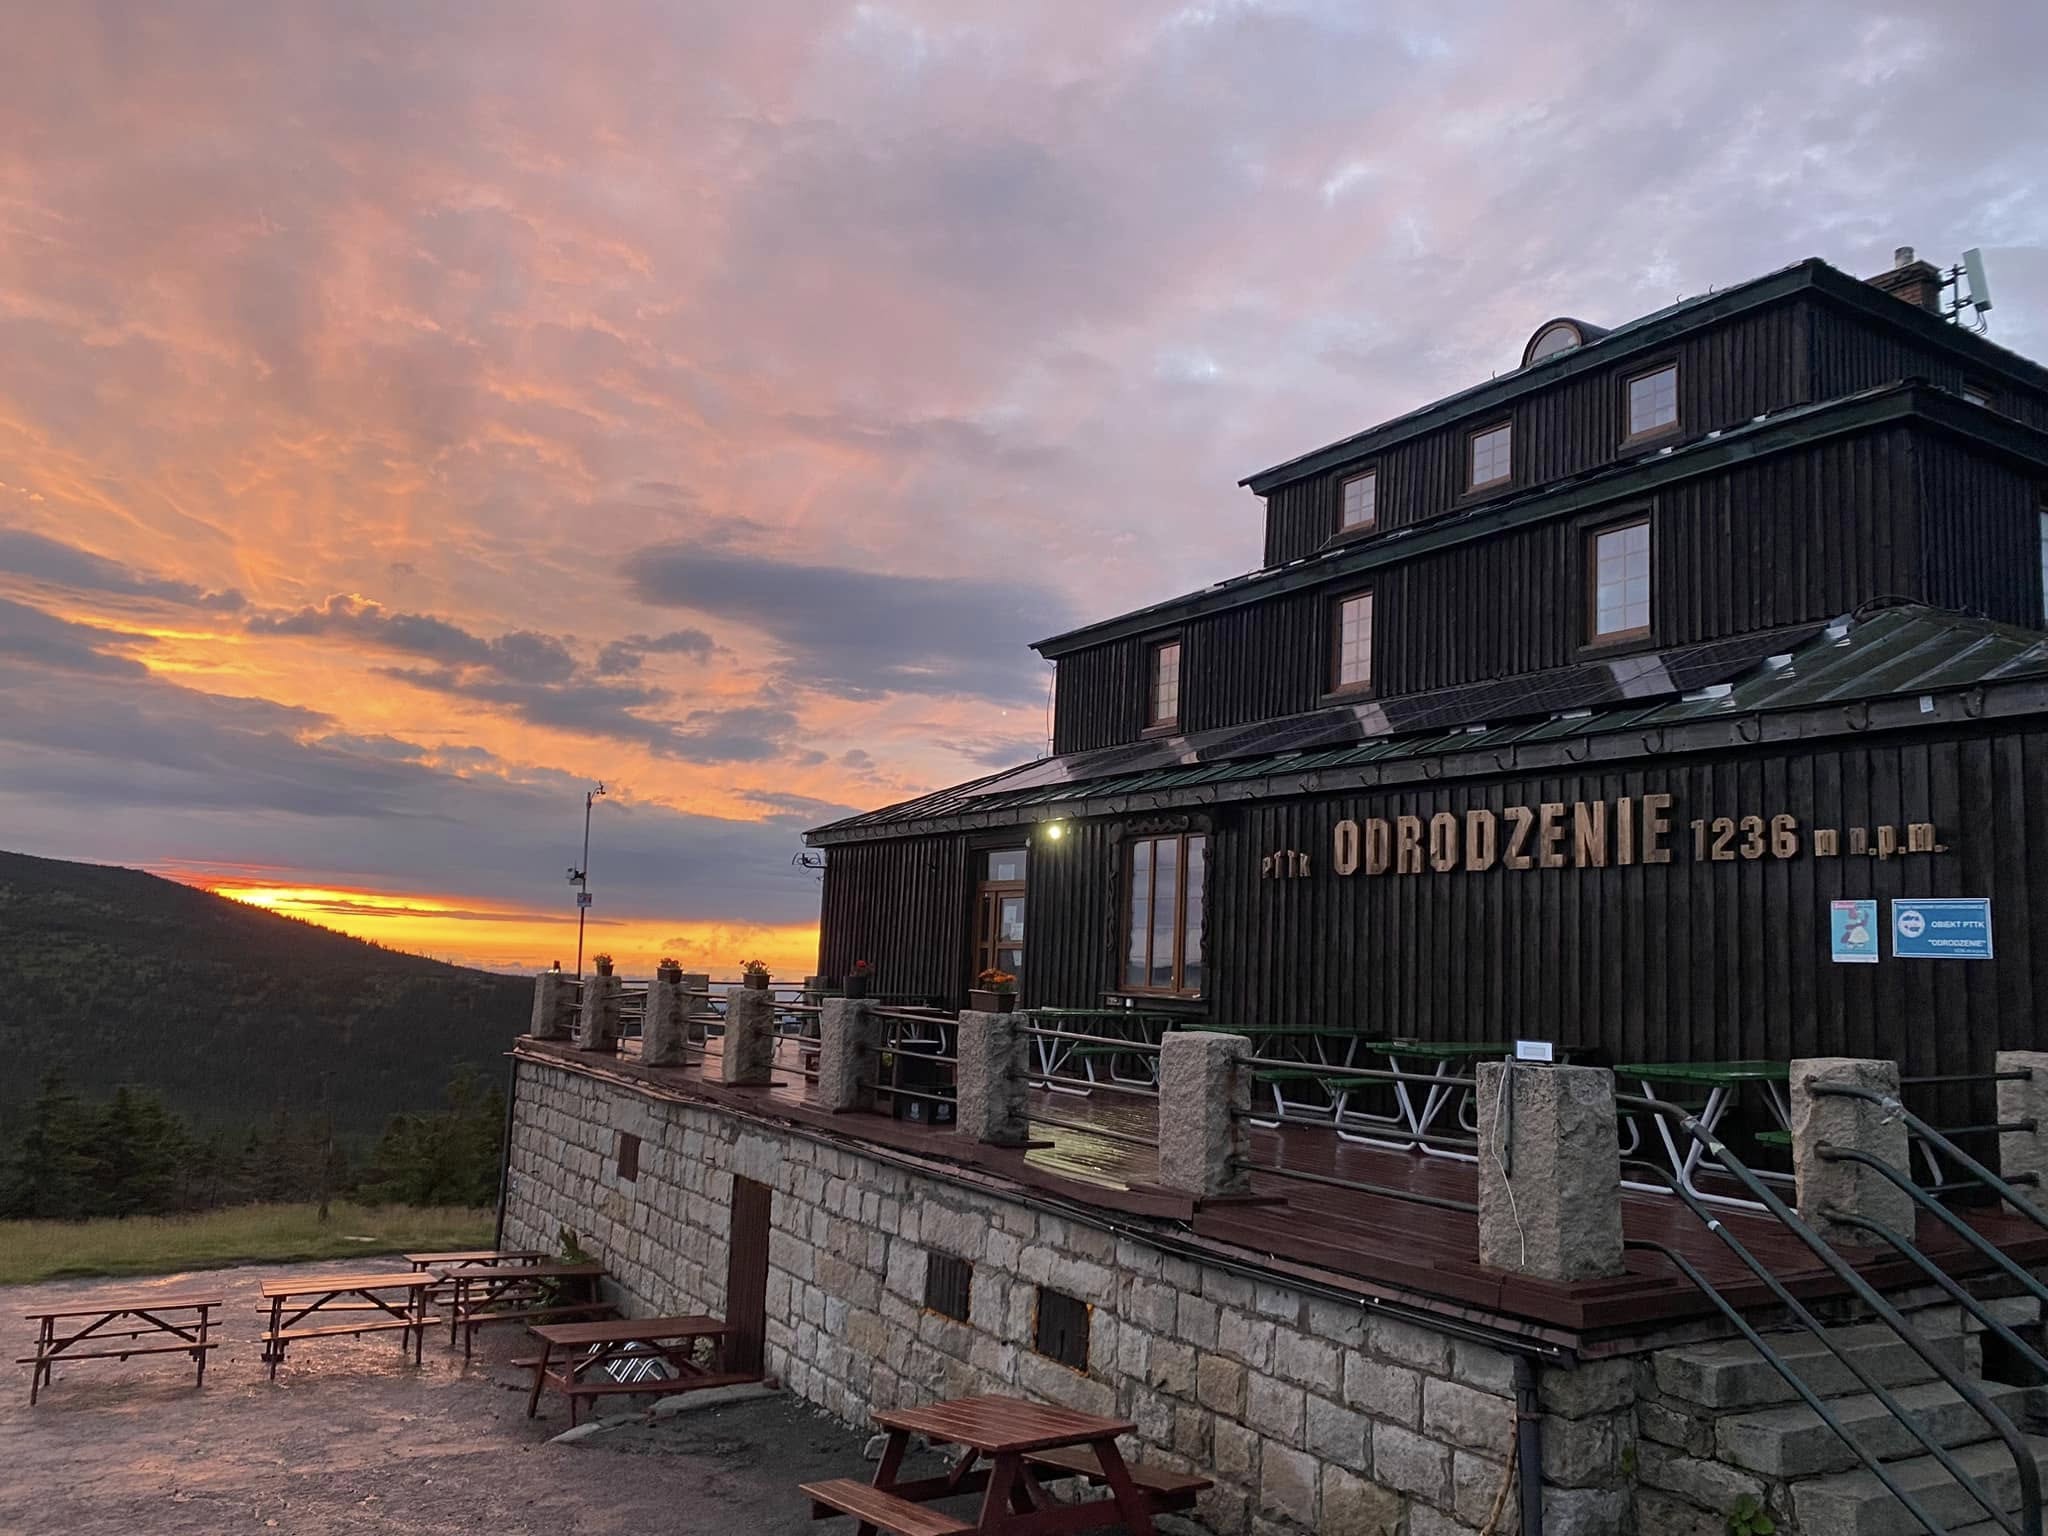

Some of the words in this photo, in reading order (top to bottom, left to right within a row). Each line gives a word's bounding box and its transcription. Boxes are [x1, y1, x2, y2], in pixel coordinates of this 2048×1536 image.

[1334, 793, 1673, 876] ODRODZENIE
[1691, 814, 1800, 862] 1236
[1814, 829, 1839, 857] m
[1849, 823, 1949, 861] n.p.m.
[1962, 920, 1985, 928] PTTK
